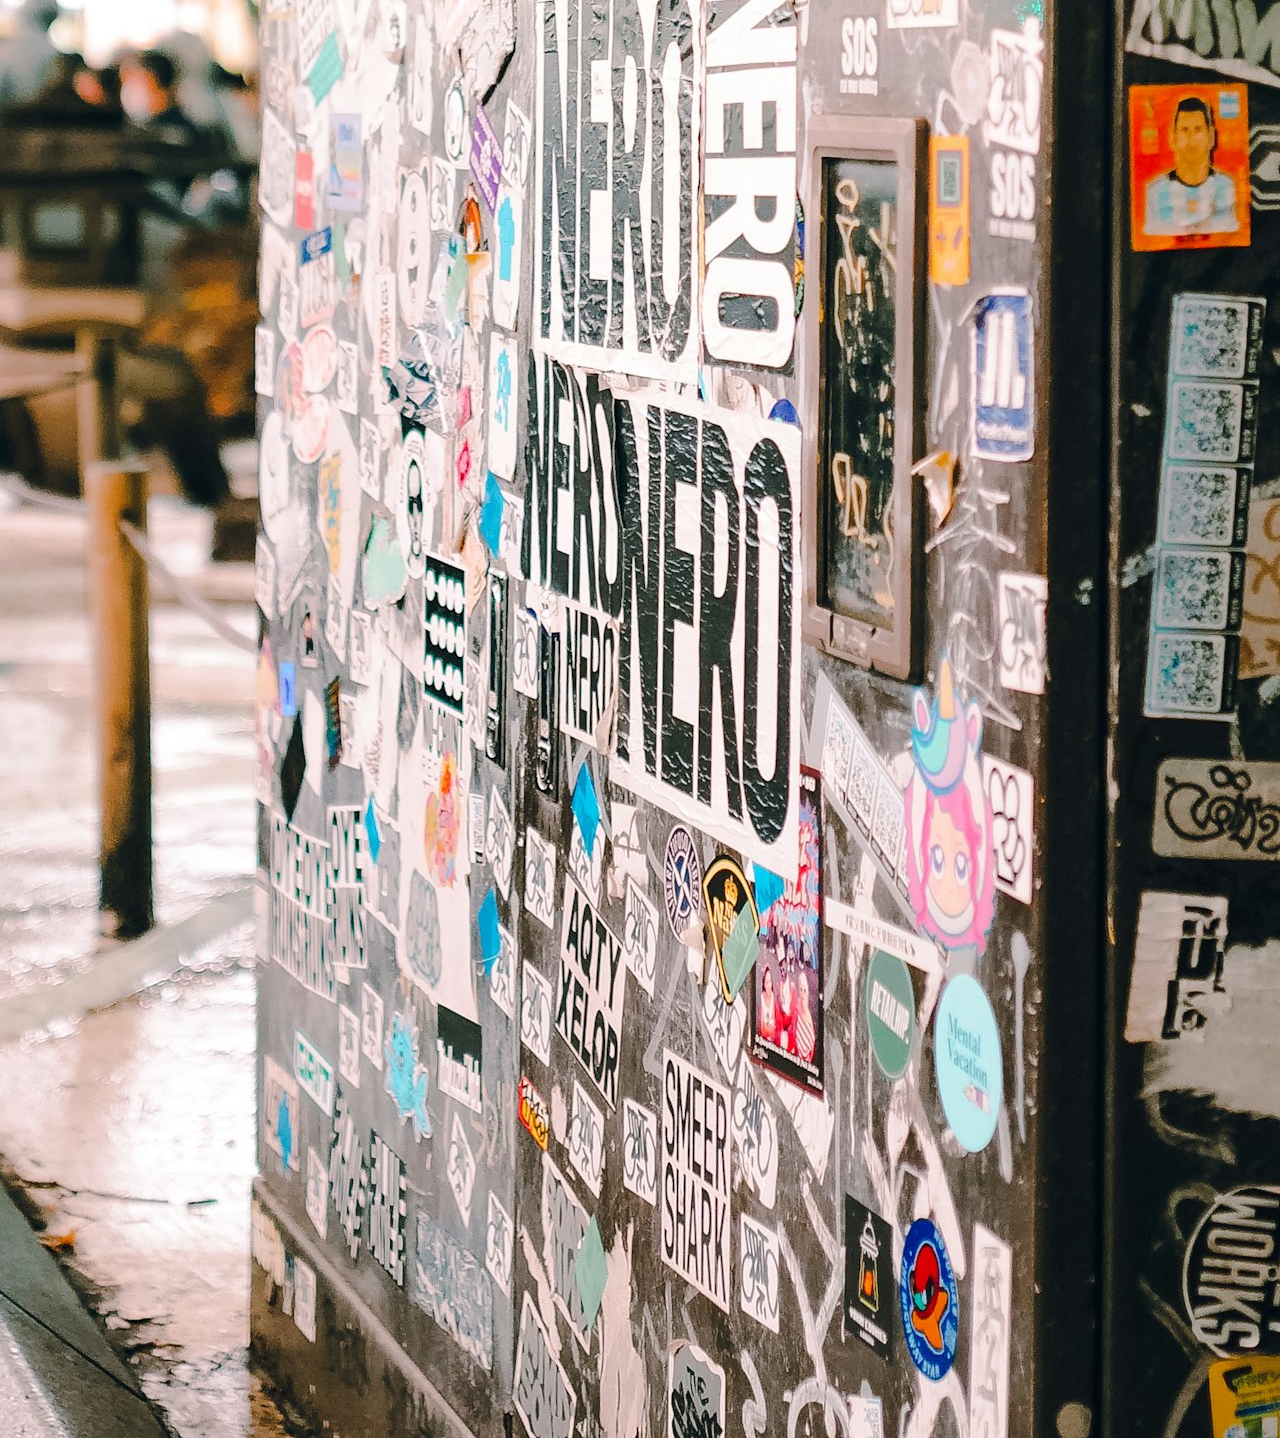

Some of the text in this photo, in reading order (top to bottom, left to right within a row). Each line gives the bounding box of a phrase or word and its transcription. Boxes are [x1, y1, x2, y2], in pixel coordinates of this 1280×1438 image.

[840, 16, 879, 77] SOS
[989, 151, 1036, 221] SOS
[522, 349, 623, 619] NERO
[621, 400, 795, 846] NERO
[567, 887, 621, 1015] AQTY
[558, 957, 619, 1107] XELOR
[947, 1039, 990, 1089] Vacation
[948, 1012, 982, 1053] Mental
[664, 1058, 729, 1198] SMEER
[664, 1172, 729, 1310] SHARK
[1192, 1193, 1280, 1349] WORKS
